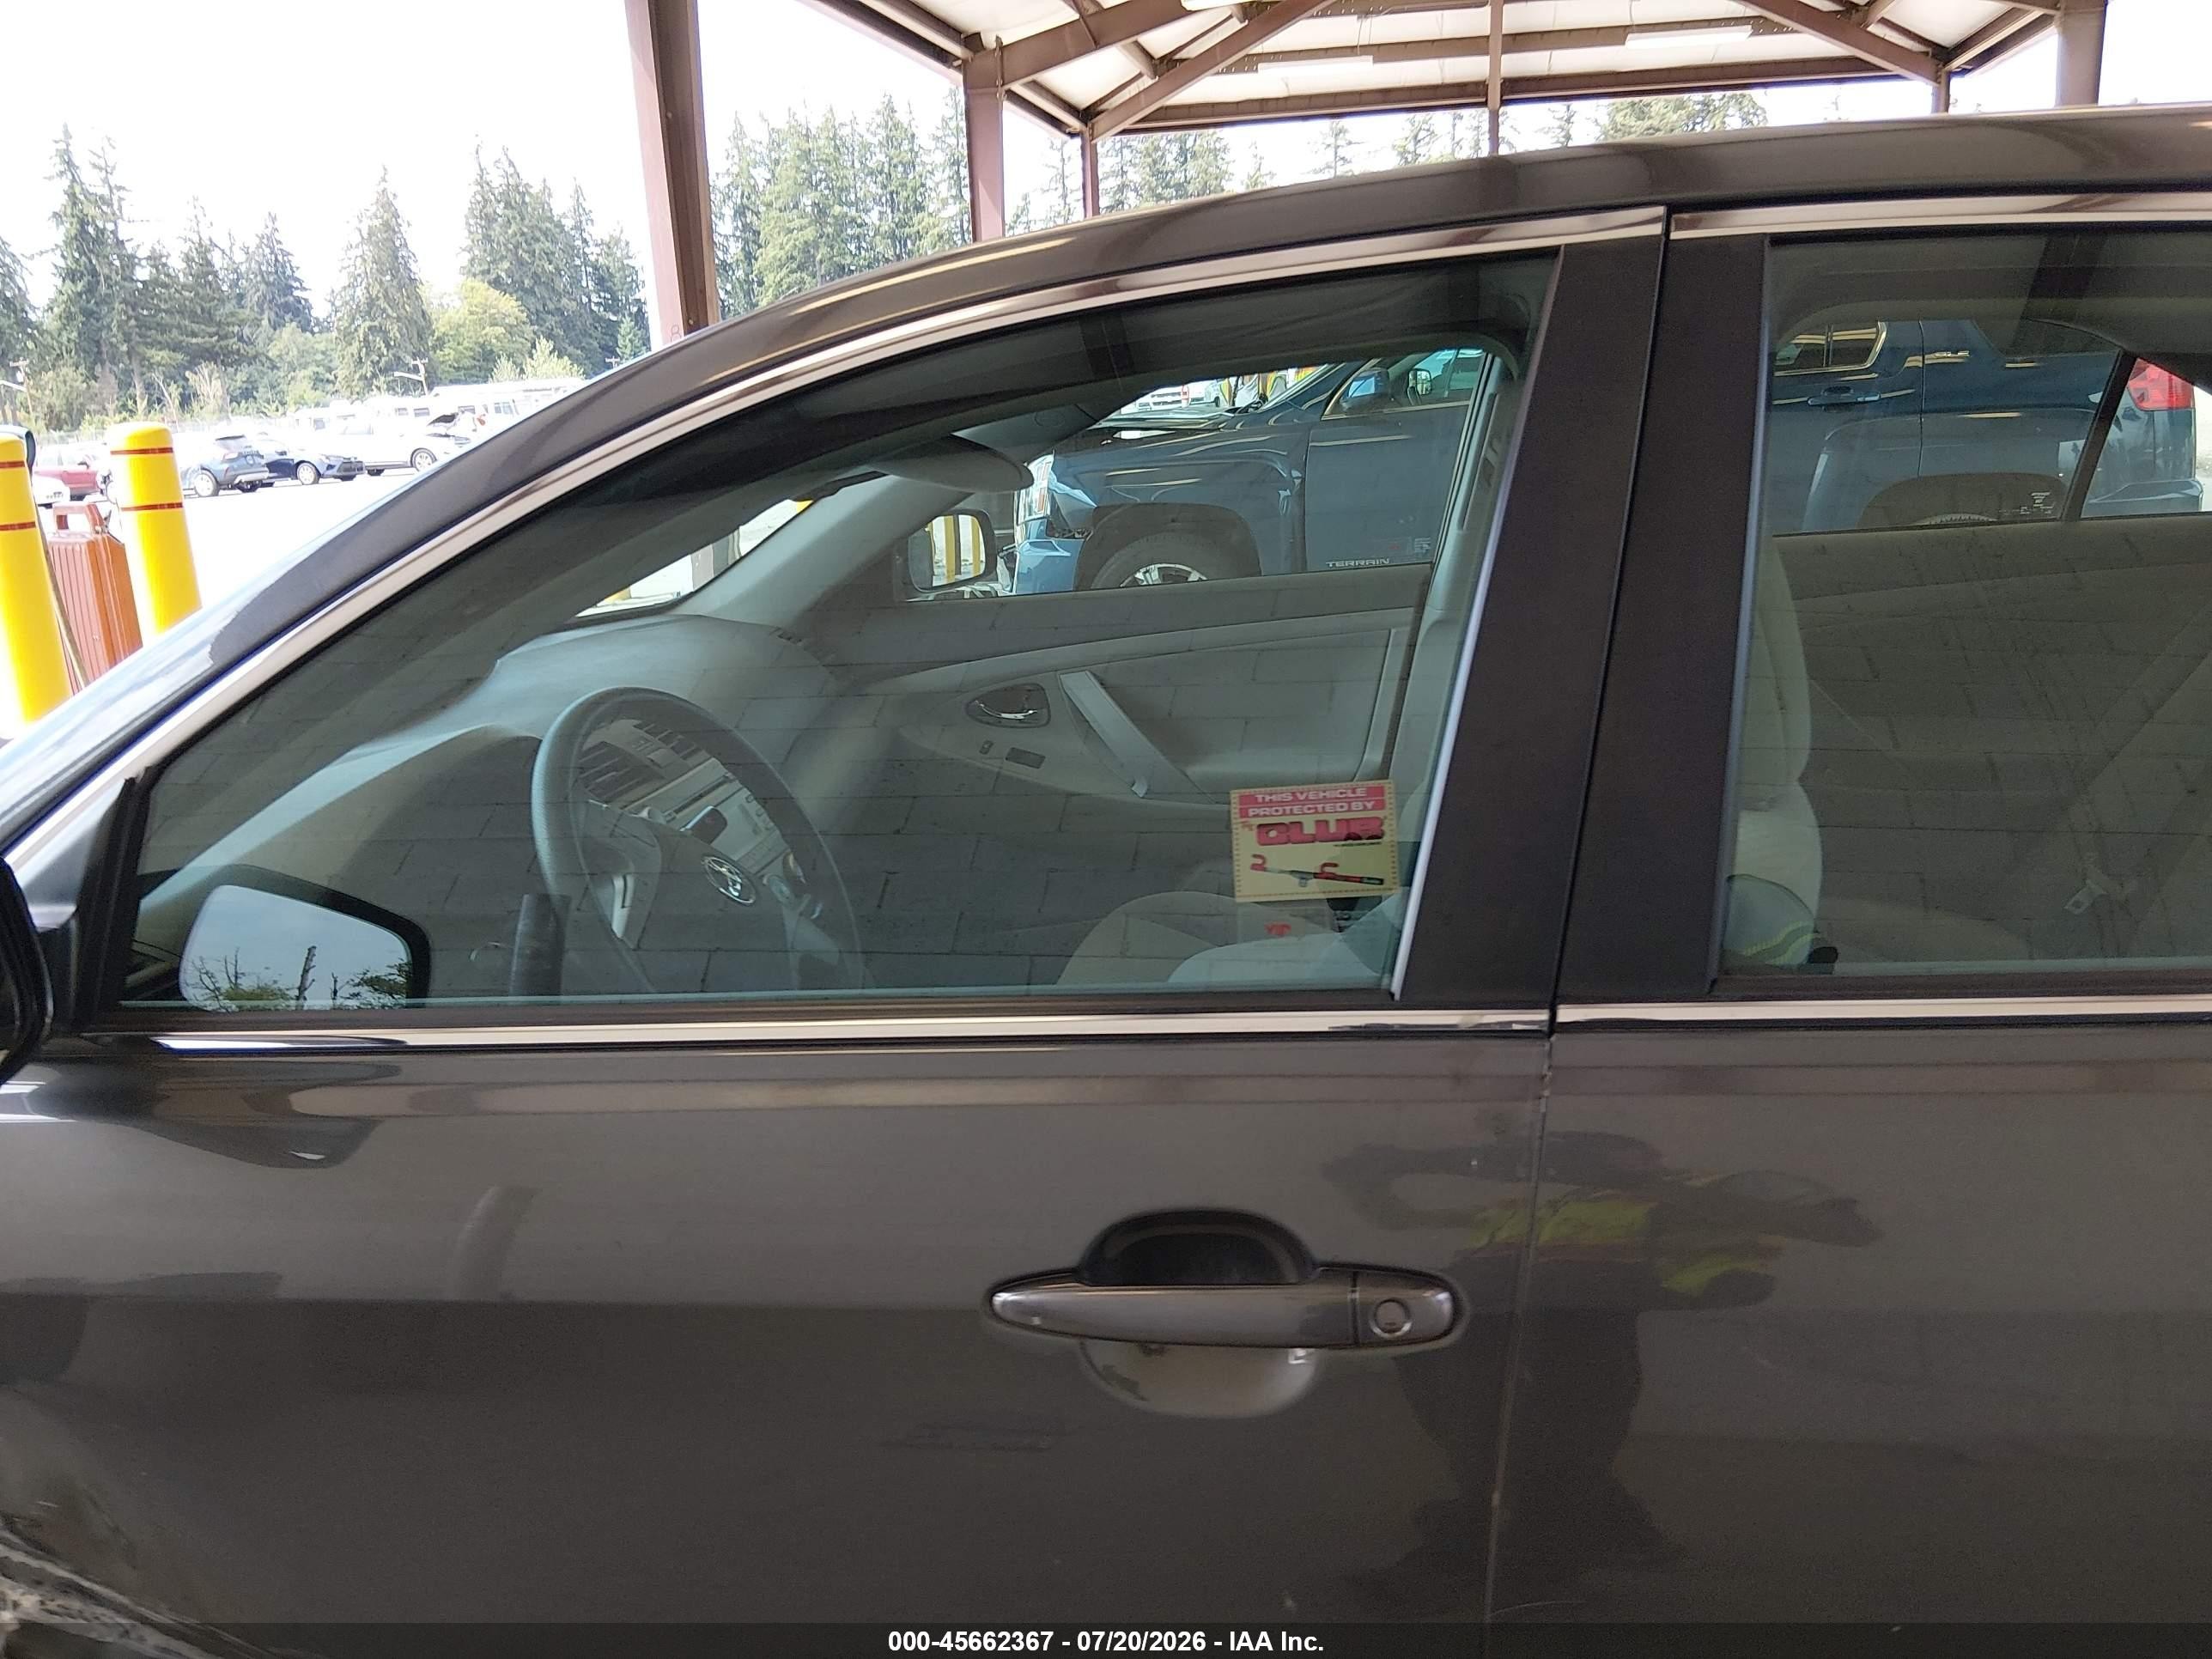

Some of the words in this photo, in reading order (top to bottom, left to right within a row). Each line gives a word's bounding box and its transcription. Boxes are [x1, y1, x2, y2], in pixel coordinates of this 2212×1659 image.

[1325, 558, 1390, 568] TERRAIN
[1255, 793, 1292, 803] THIS
[1295, 787, 1368, 800] VEHICLE
[1248, 802, 1349, 817] PROTECTED
[1350, 800, 1376, 811] BY
[1256, 817, 1385, 846] CLUB
